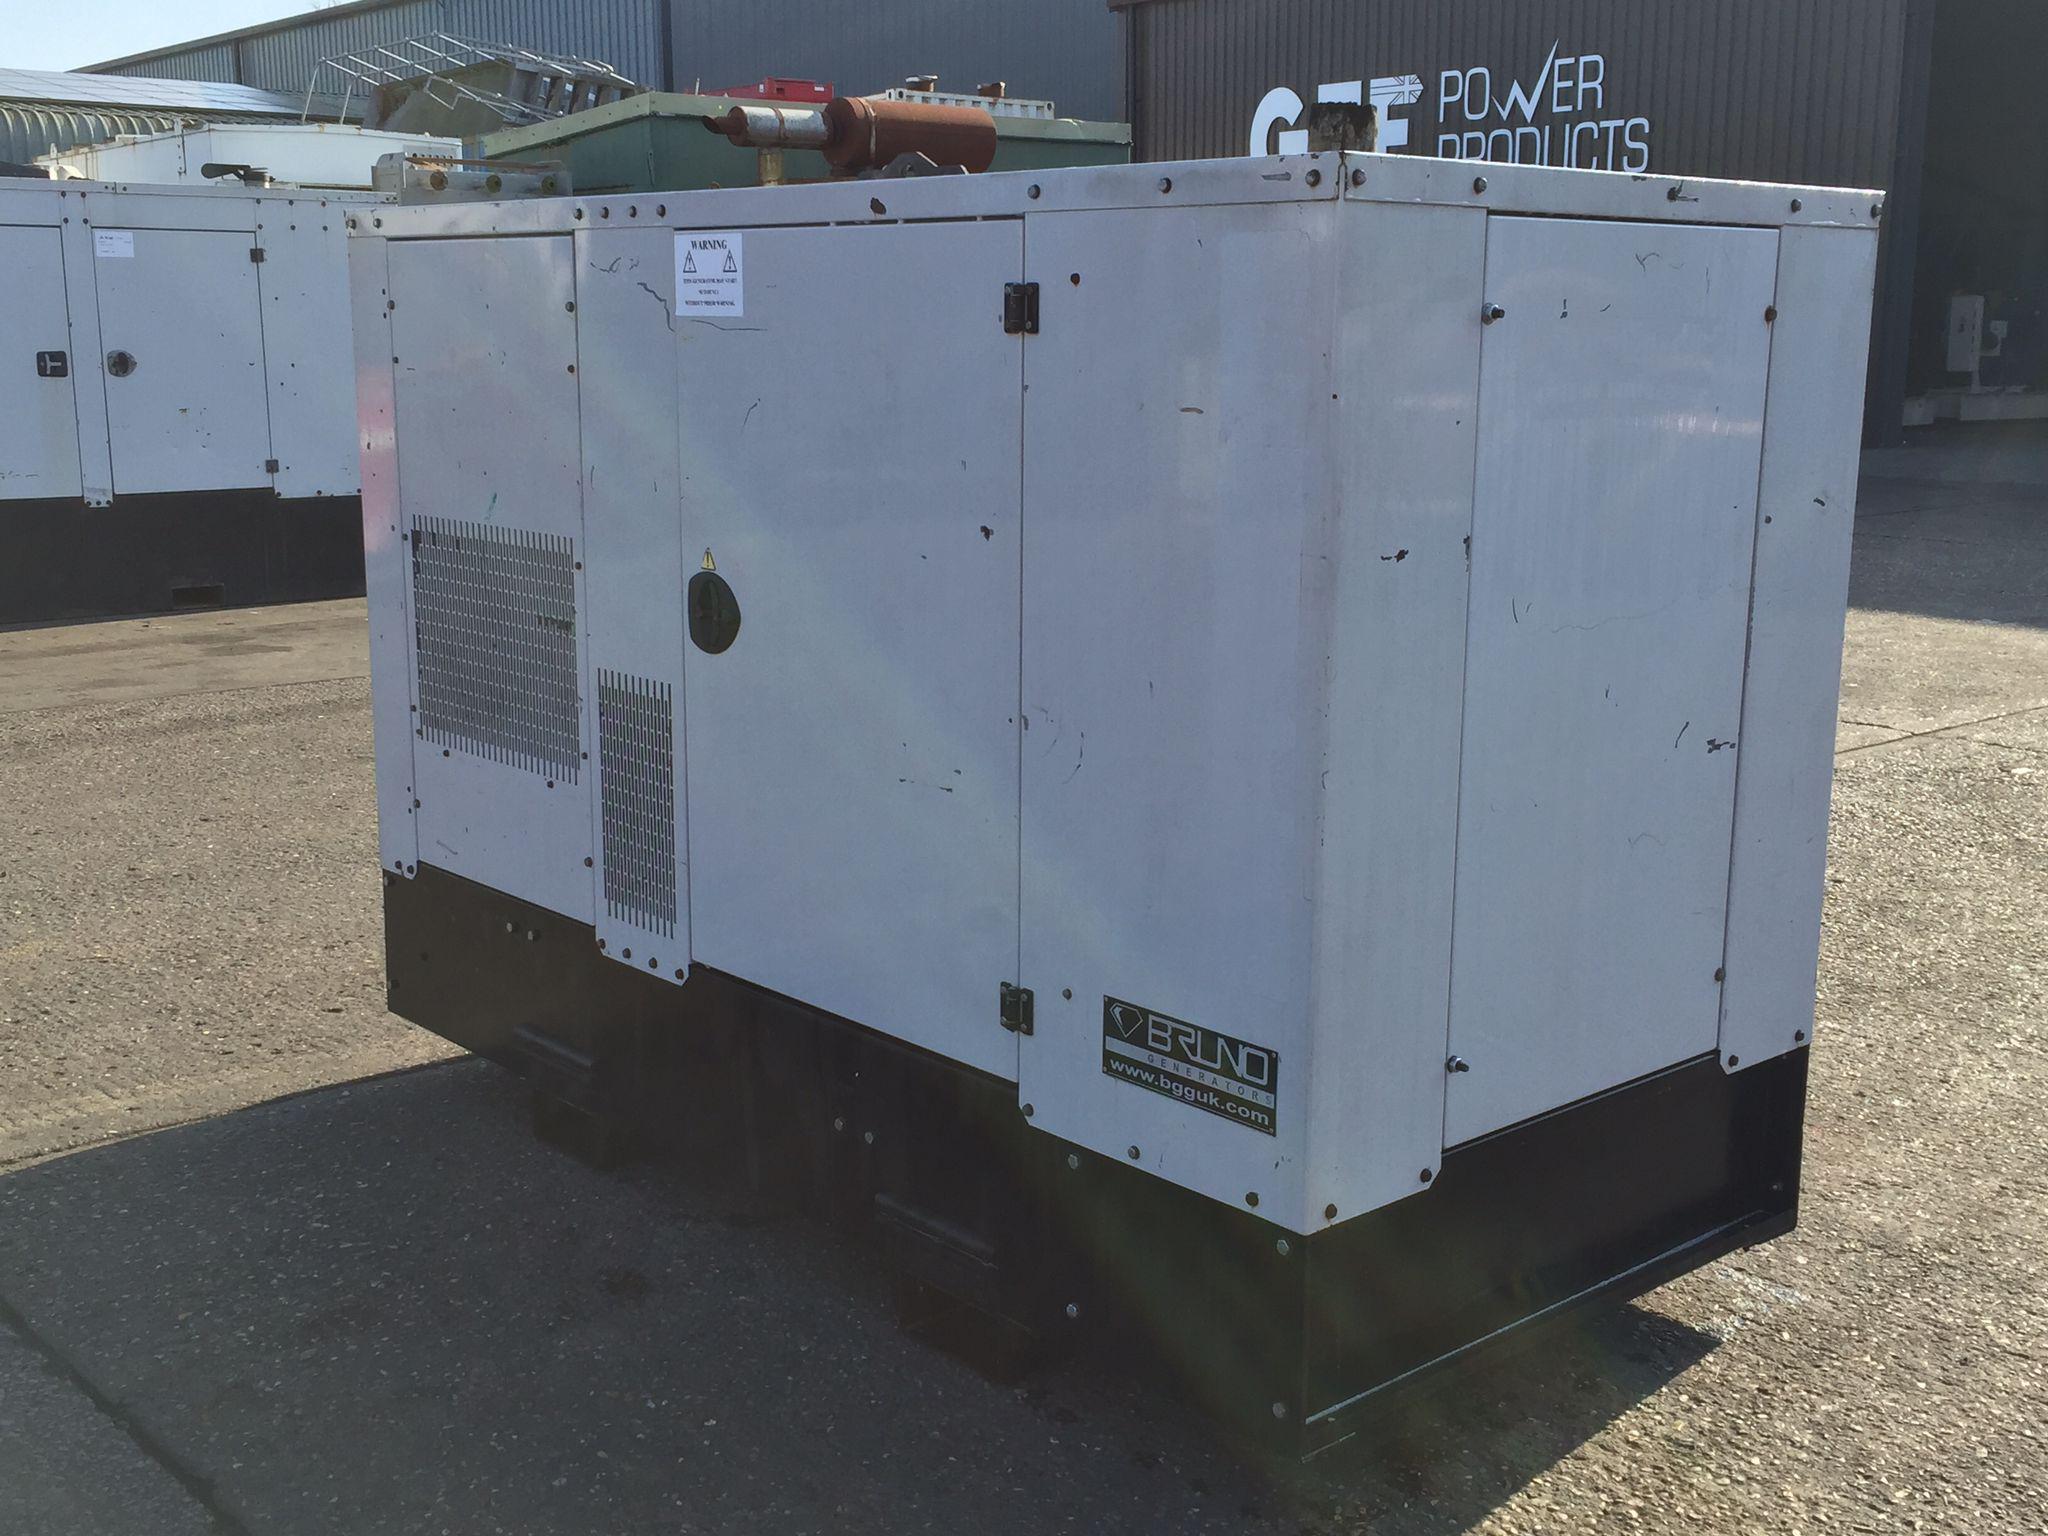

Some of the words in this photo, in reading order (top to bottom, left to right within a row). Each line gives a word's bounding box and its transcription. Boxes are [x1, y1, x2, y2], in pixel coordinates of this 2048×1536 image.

[1438, 38, 1605, 123] POWER
[691, 239, 727, 250] WARNING
[1147, 1013, 1269, 1086] BRUNO
[1147, 1053, 1273, 1105] GENERATORS
[1109, 1058, 1270, 1126] www.bgguk.com
